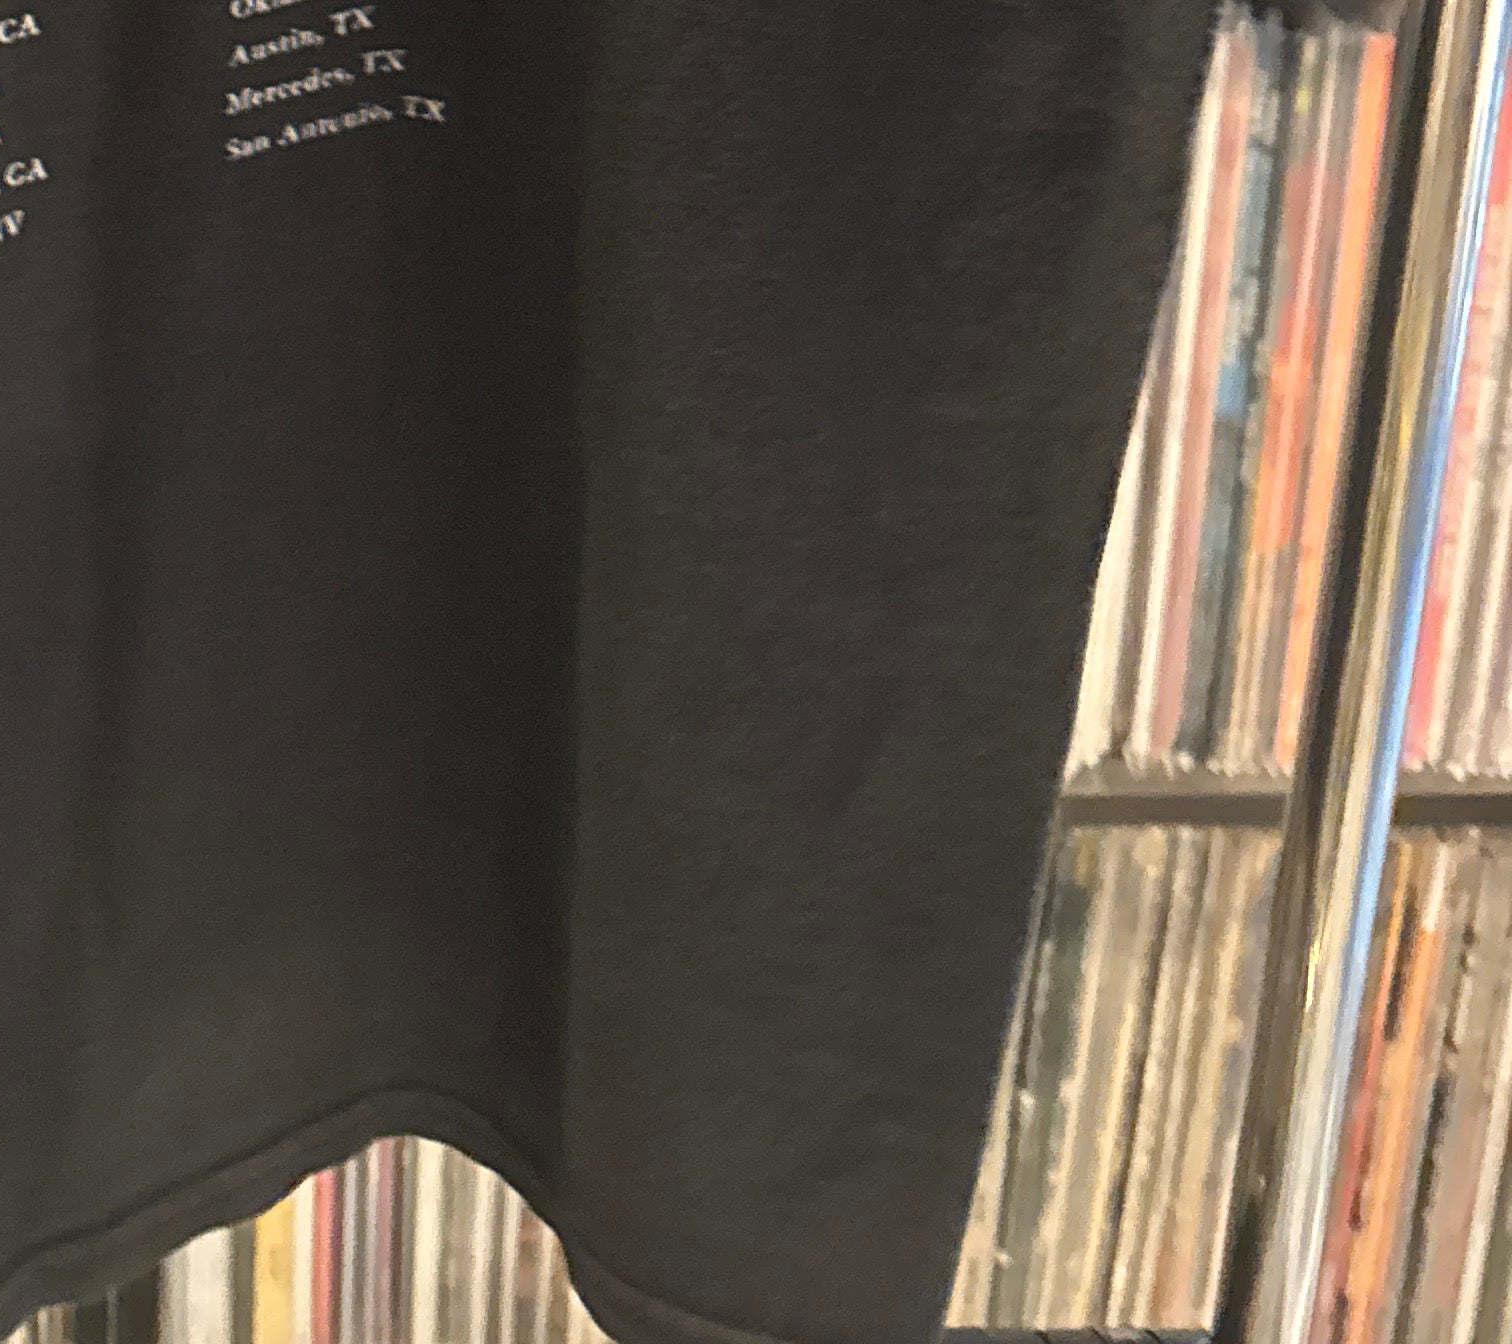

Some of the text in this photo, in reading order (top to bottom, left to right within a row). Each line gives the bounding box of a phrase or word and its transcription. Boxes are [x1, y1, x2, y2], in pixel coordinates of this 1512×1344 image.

[228, 4, 377, 69] Austin, TX
[361, 48, 409, 75] TX
[3, 157, 49, 188] CA
